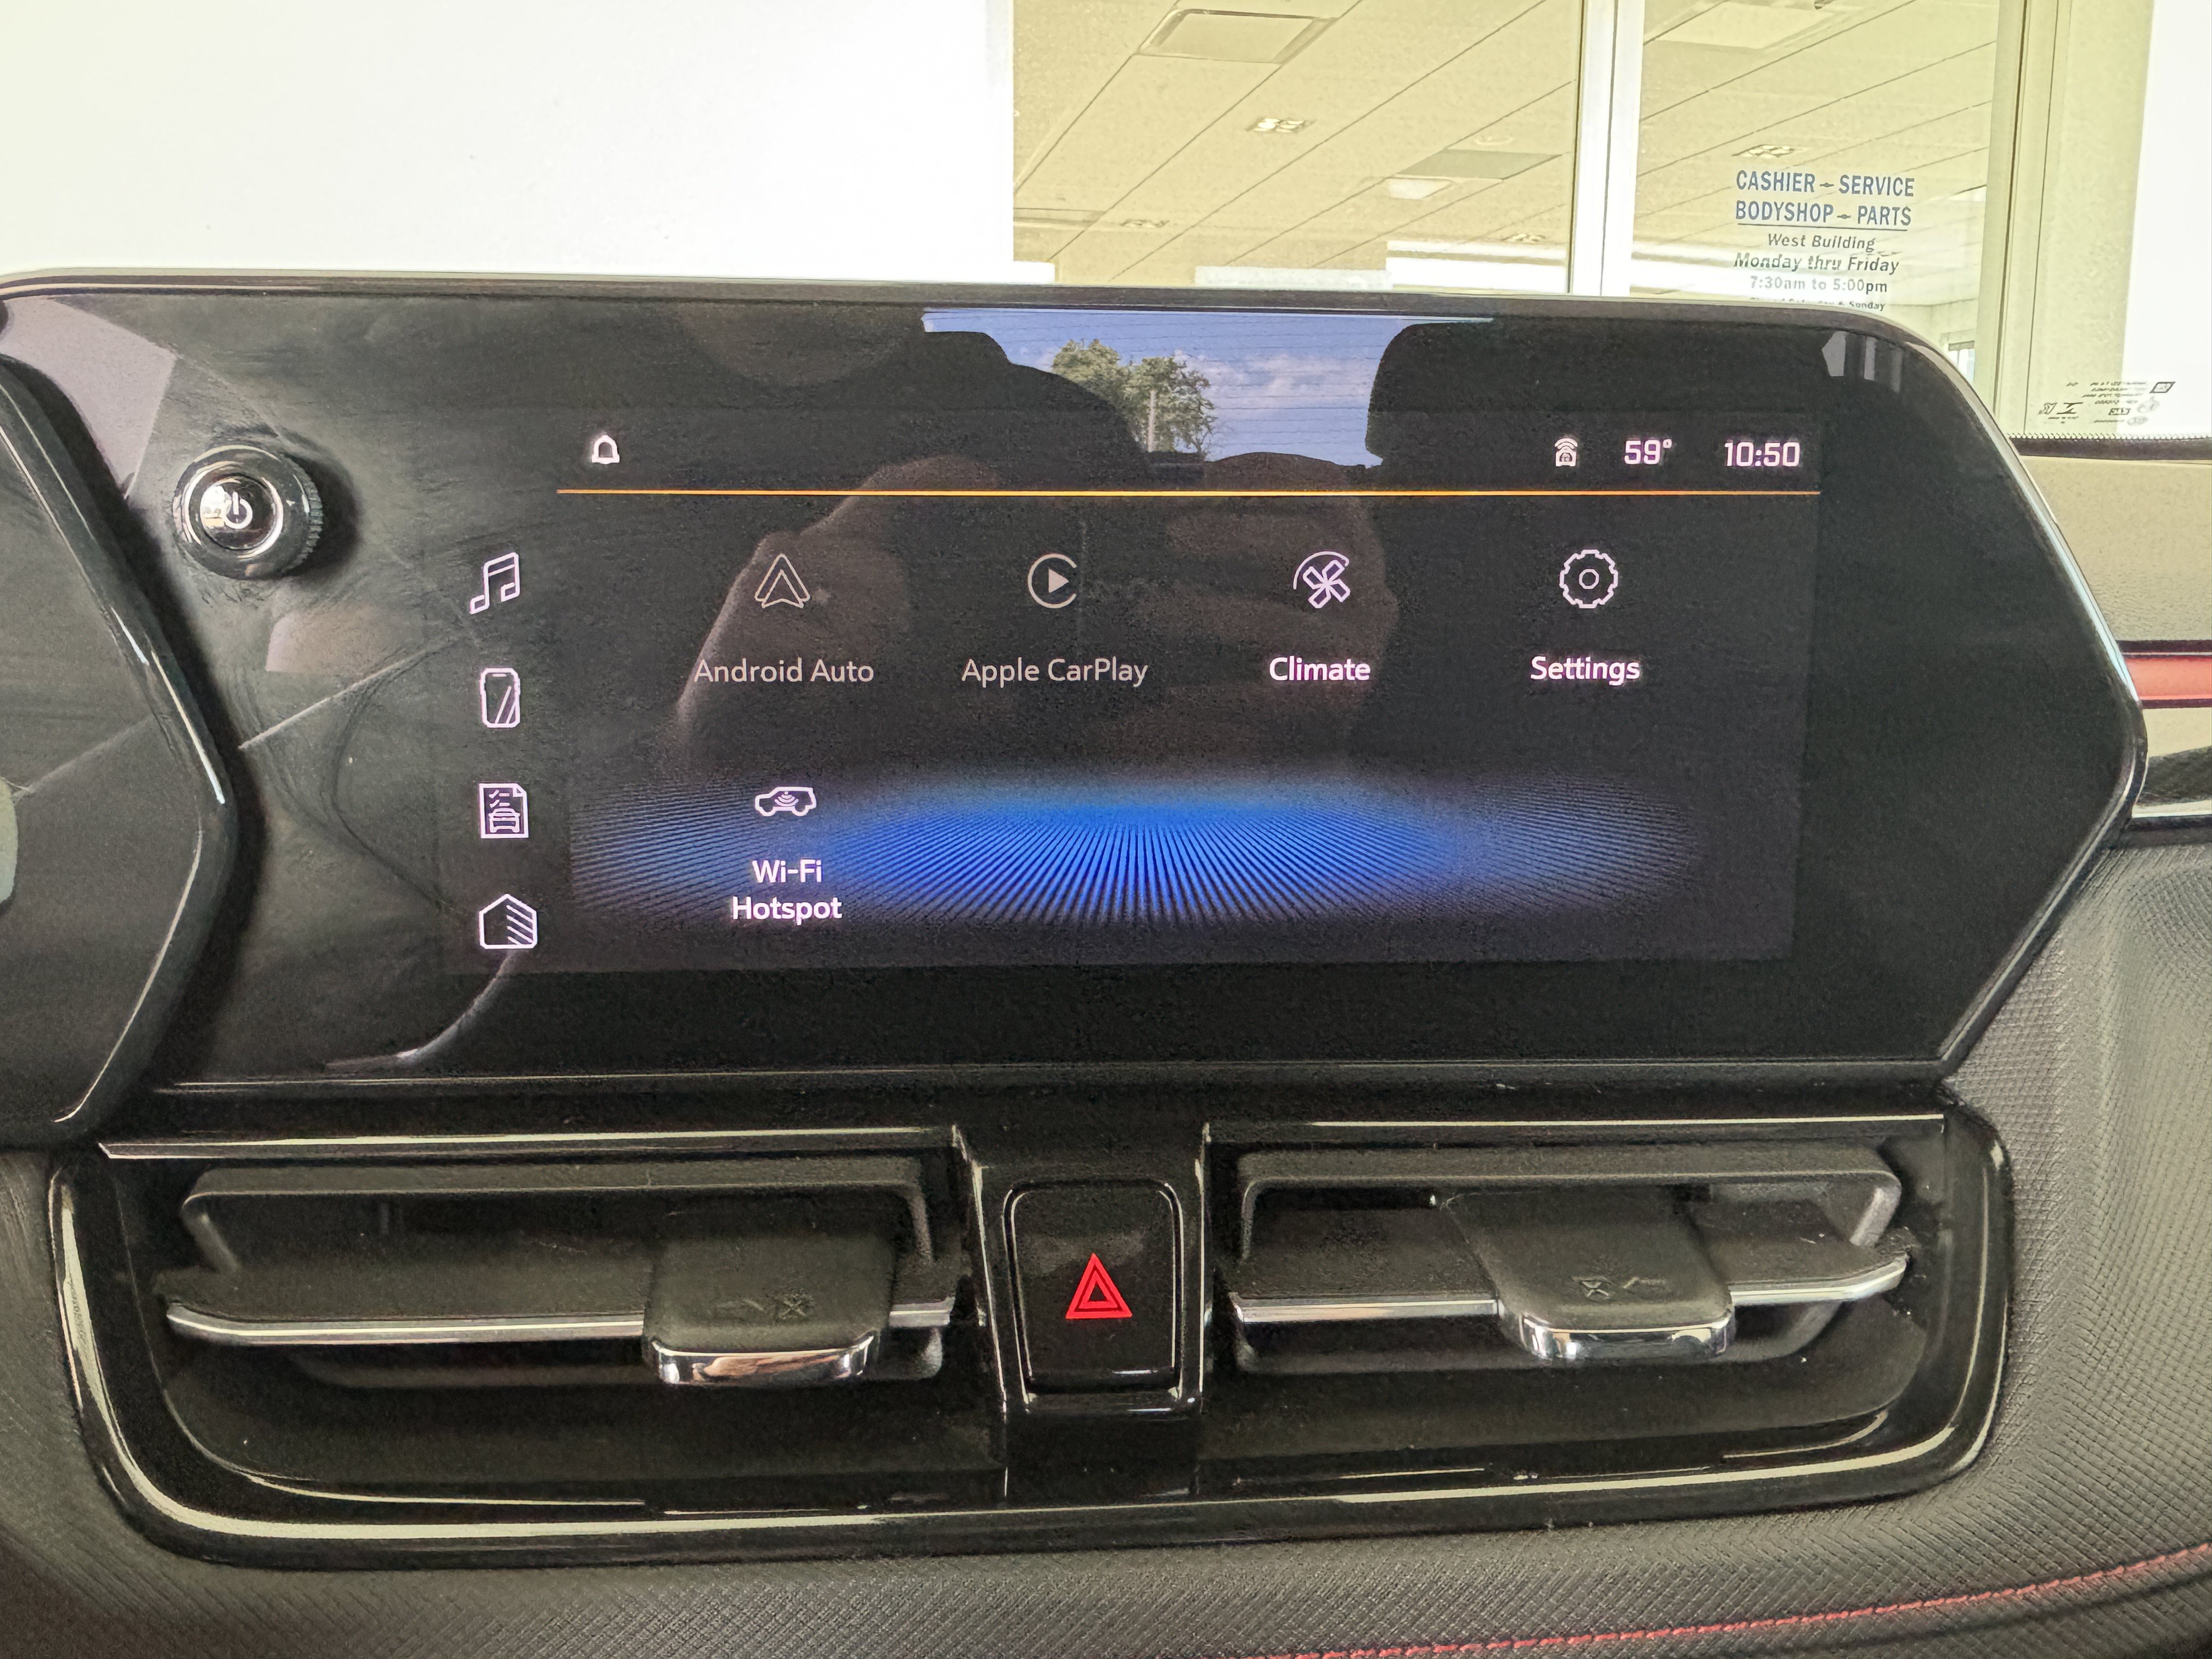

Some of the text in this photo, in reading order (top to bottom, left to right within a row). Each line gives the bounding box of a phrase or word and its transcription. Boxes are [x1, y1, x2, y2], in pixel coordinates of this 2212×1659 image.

[1736, 170, 1915, 198] CASHIER SERVICE
[1736, 200, 1912, 227] BODYSHOP PARTS
[1768, 233, 1876, 253] West Building
[1734, 252, 1900, 275] Monday thru Friday
[1750, 275, 1888, 295] 7:30am to 5:00pm
[1624, 438, 1672, 465] 59°
[1724, 440, 1800, 467] 10:50
[693, 656, 874, 683] Android Auto
[961, 656, 1149, 689] Apple CarPlay
[1269, 656, 1371, 681] Climate
[1530, 655, 1641, 686] Settings
[752, 859, 822, 883] Wi-Fi
[732, 895, 843, 926] Hotspot
